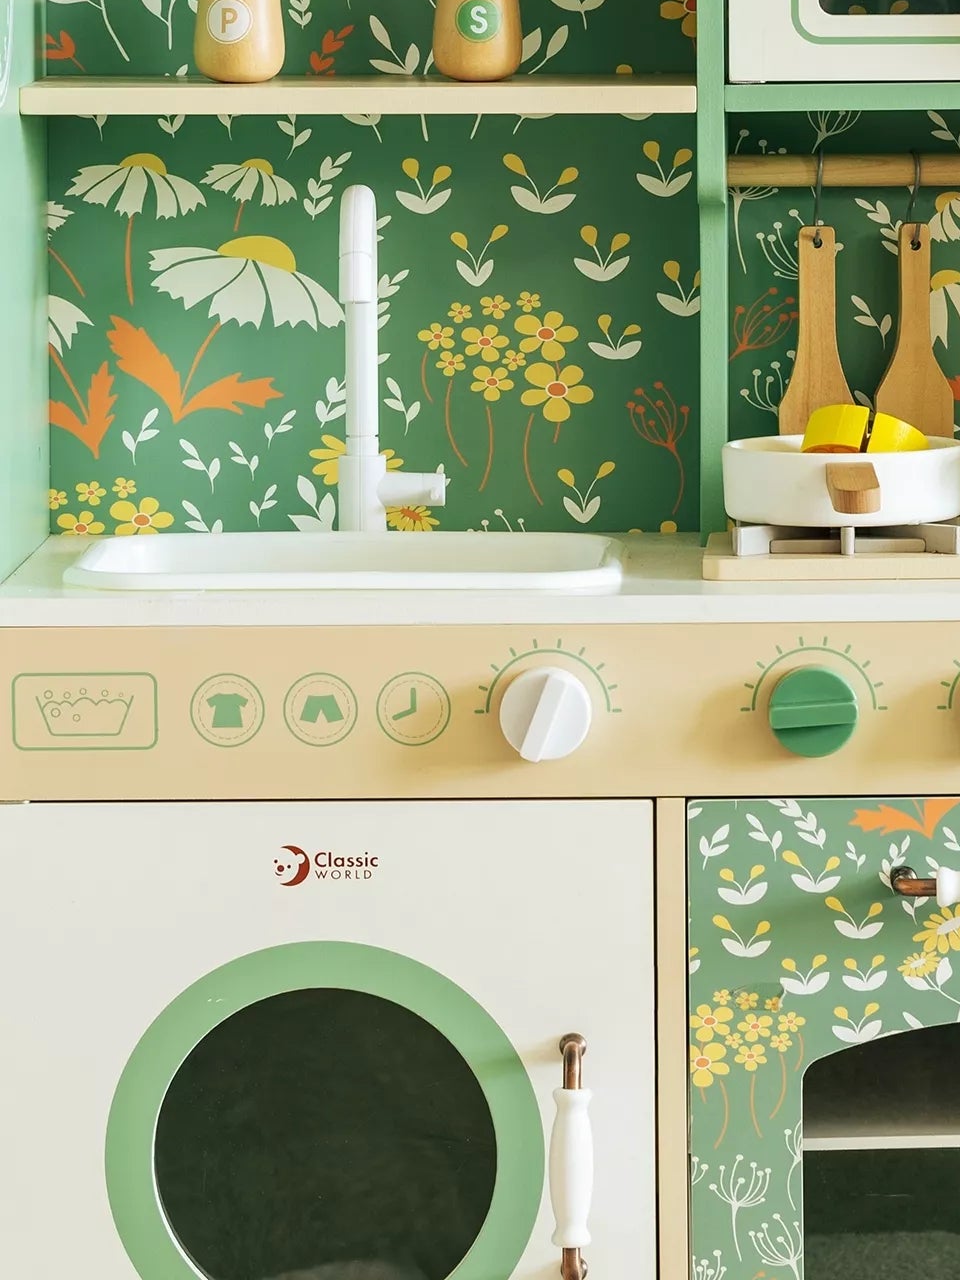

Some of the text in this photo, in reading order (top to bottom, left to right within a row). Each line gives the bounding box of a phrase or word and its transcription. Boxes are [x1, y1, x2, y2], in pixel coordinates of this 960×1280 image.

[221, 8, 238, 33] P
[469, 6, 488, 34] S
[314, 851, 379, 868] Classic
[314, 869, 372, 880] WORLD
